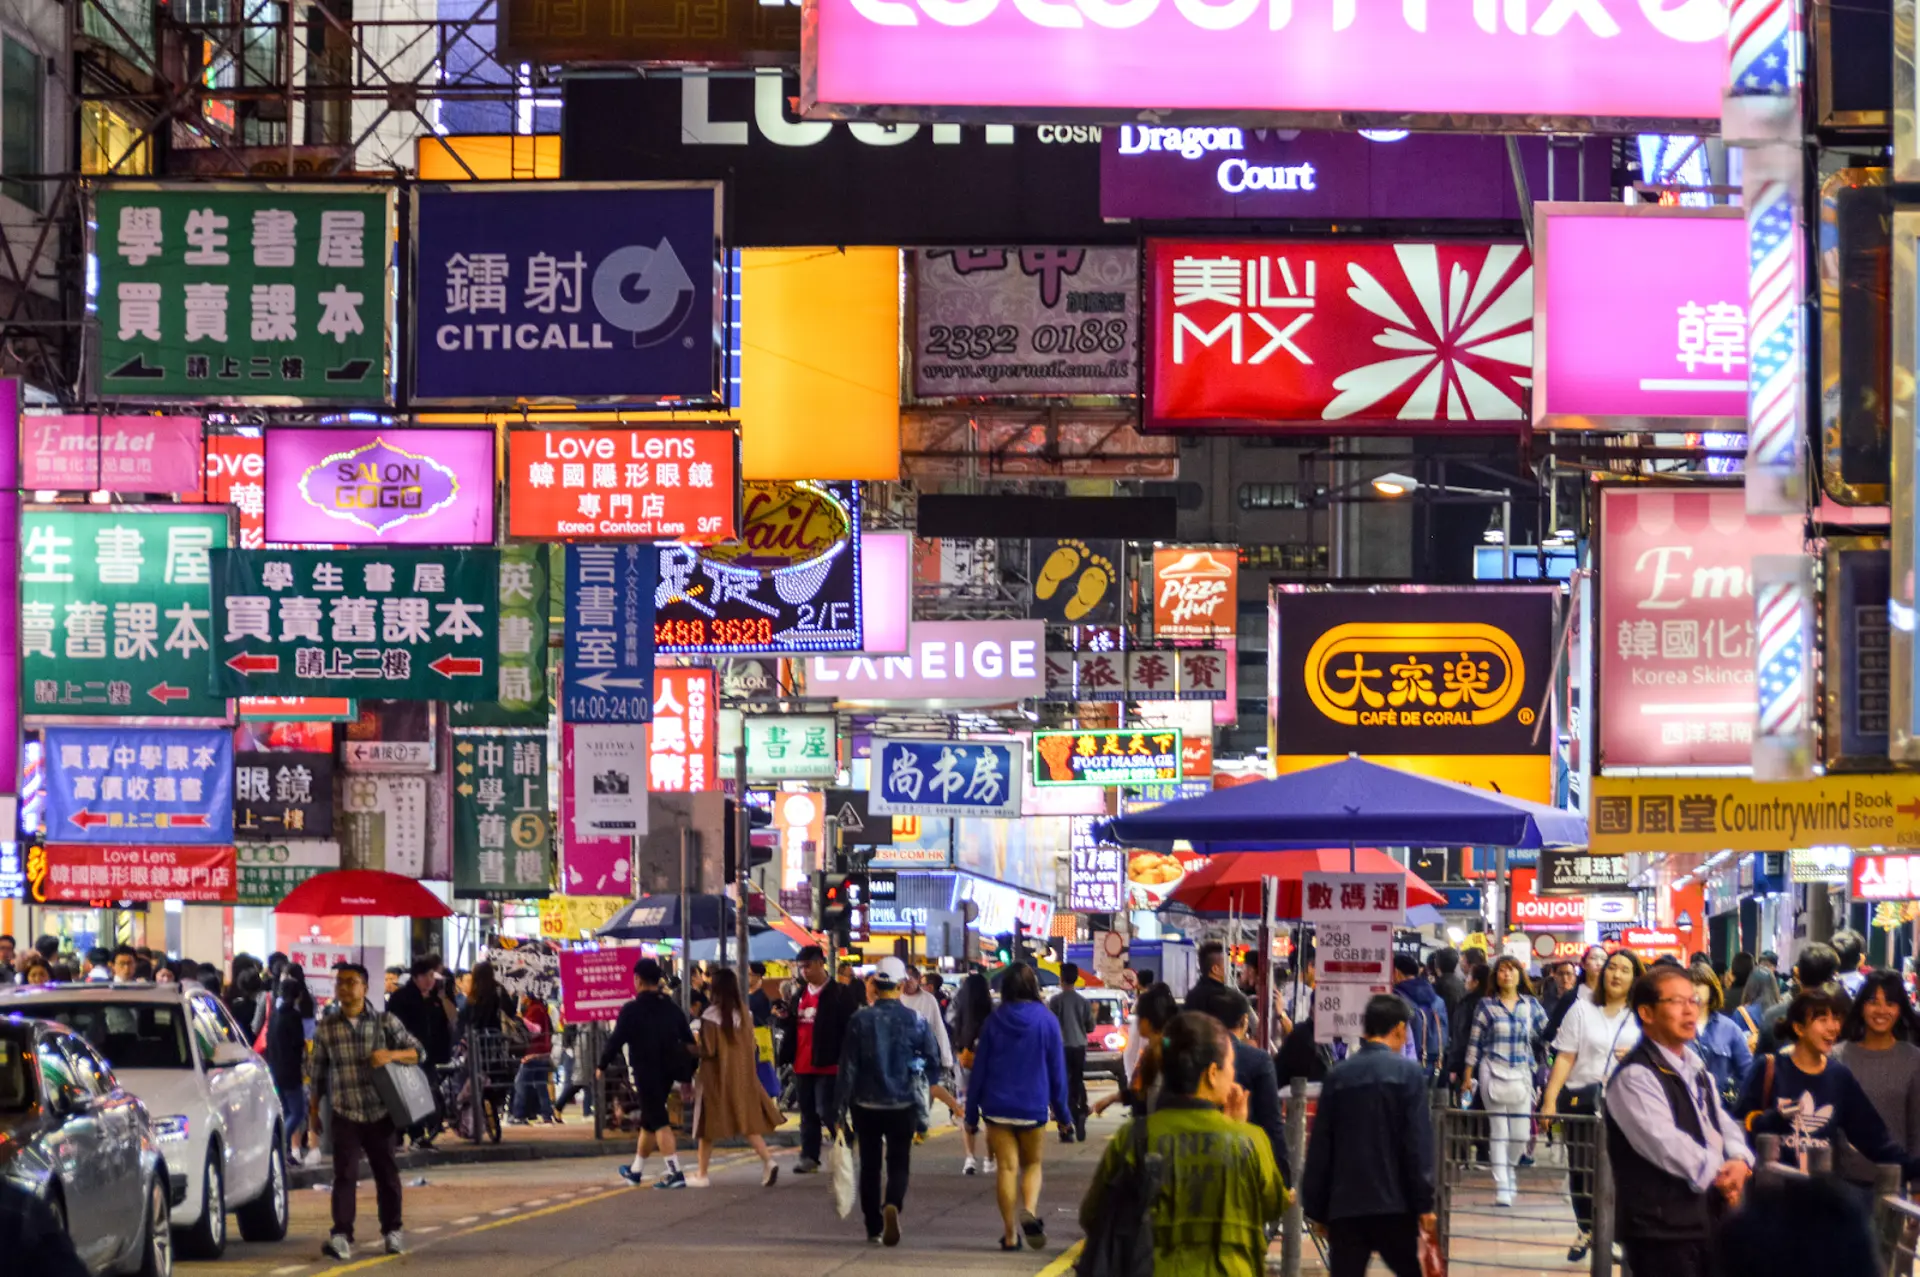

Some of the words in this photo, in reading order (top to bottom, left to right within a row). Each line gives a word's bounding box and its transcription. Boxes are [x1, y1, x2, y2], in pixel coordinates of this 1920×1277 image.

[1118, 124, 1243, 159] Dragon
[1217, 158, 1317, 193] Court
[117, 206, 365, 268] 學生書屋
[445, 251, 588, 315] 鐳射
[1173, 256, 1316, 308] 美心
[117, 284, 365, 344] 買賣課本
[436, 323, 613, 350] CITICALL
[925, 325, 1019, 360] 2332
[1032, 318, 1128, 354] 0188
[1173, 313, 1315, 365] MX
[186, 355, 304, 380] 請上二樓
[545, 433, 615, 459] Love
[631, 433, 695, 459] Lens
[337, 462, 420, 484] SALON
[529, 462, 714, 490] 韓國隱形眼鏡
[335, 485, 422, 509] GOGO
[577, 493, 665, 519] 專門店
[557, 520, 595, 534] Korea
[600, 520, 653, 534] Contact
[657, 520, 685, 534] Lens
[697, 516, 723, 534] 3/F
[262, 562, 446, 592] 學生書屋
[1635, 546, 1753, 609] Em
[1159, 576, 1228, 609] Pizza
[224, 595, 485, 644] 買賣舊課本
[797, 602, 850, 630] 2/F
[1171, 595, 1225, 624] Hut
[499, 562, 534, 702] 英書局
[295, 647, 412, 679] 請上二樓
[1632, 667, 1687, 685] Korea
[34, 679, 132, 705] 請上二樓
[724, 677, 767, 688] SALON
[570, 696, 648, 720] 14:00-24:00
[1401, 711, 1420, 725] DE
[1423, 711, 1472, 725] CORAL
[888, 745, 1004, 805] 尚书房
[1072, 756, 1110, 769] FOOT
[1110, 754, 1175, 768] MASSAGE
[236, 765, 313, 804] 眼鏡
[1854, 790, 1893, 808] Book
[232, 808, 304, 831] 上一樓
[1595, 794, 1717, 835] 國風堂
[1720, 790, 1850, 841] Countrywind
[1853, 812, 1894, 828] Store
[103, 849, 139, 863] Love
[143, 849, 176, 864] Lens
[1308, 883, 1399, 911] 數碼通
